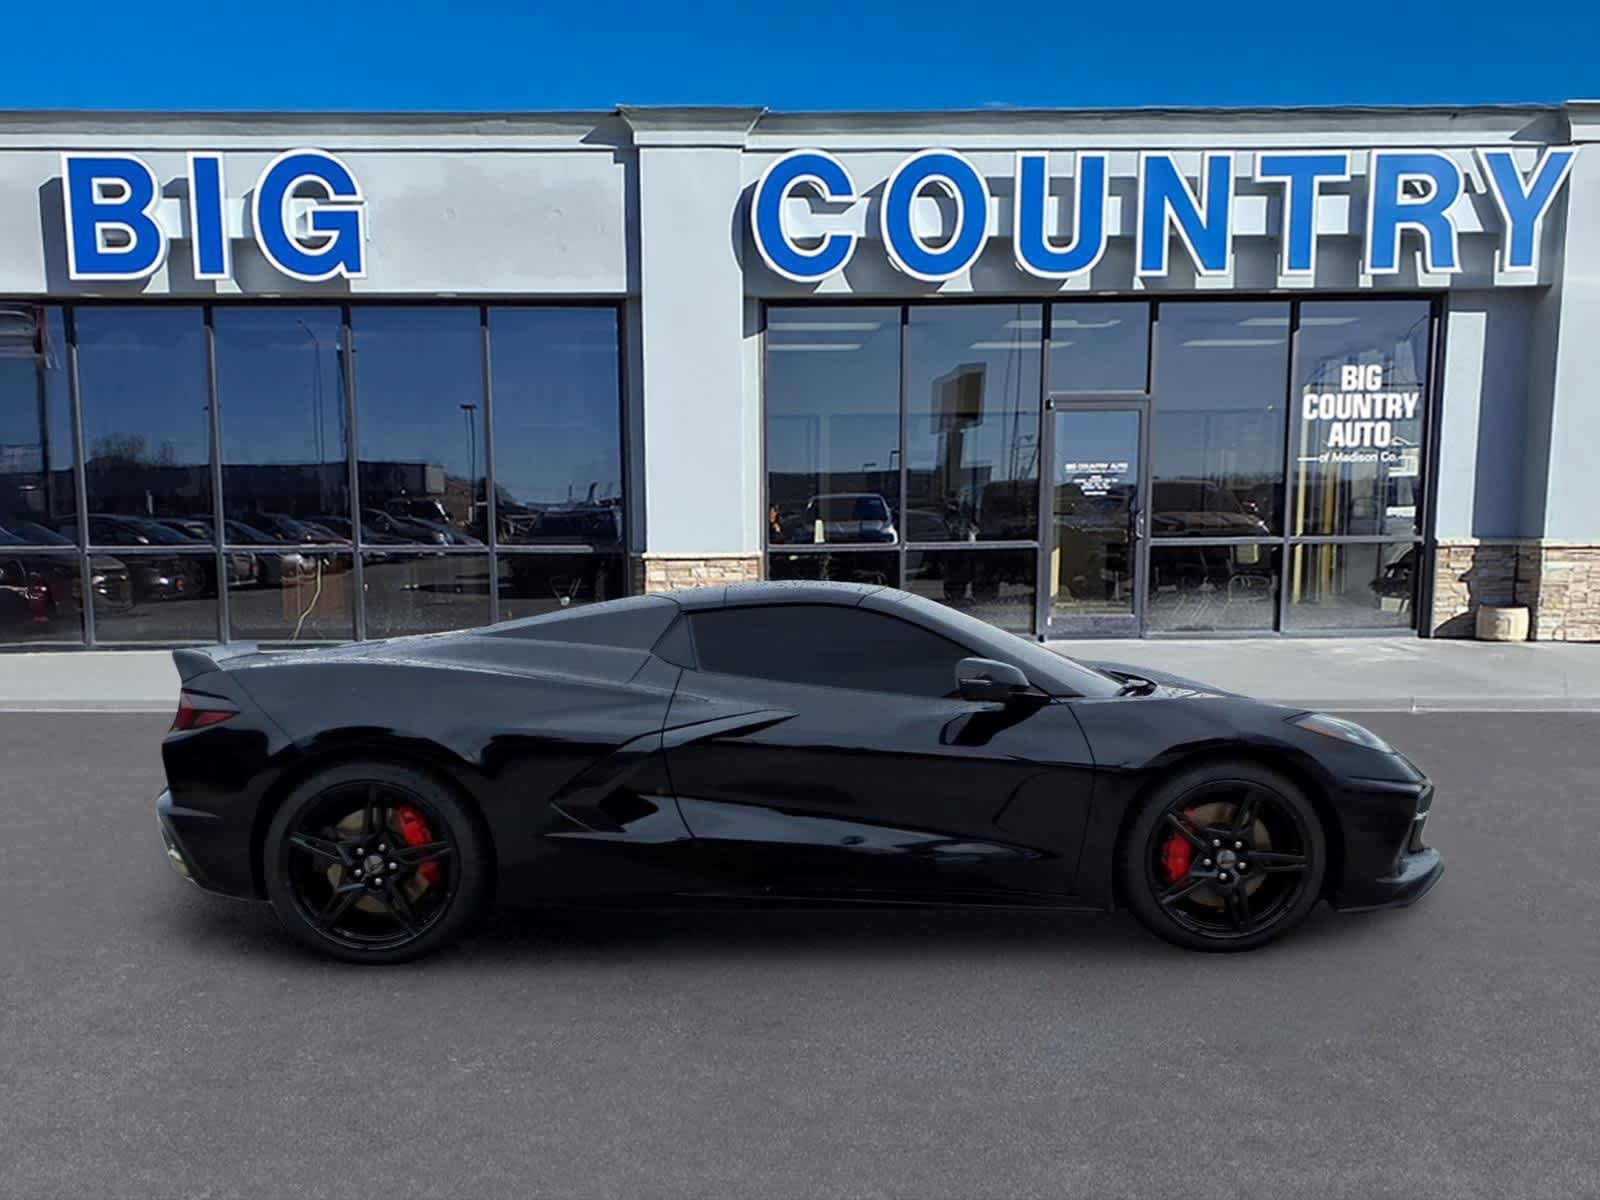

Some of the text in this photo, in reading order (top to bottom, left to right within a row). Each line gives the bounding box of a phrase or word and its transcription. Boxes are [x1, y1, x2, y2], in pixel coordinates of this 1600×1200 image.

[60, 147, 1579, 283] BIG COUNTRY
[1341, 364, 1382, 391] BIG
[1302, 392, 1419, 419] COUNTRY
[1327, 420, 1391, 448] AUTO
[1319, 451, 1330, 463] of
[1331, 451, 1378, 462] Madison
